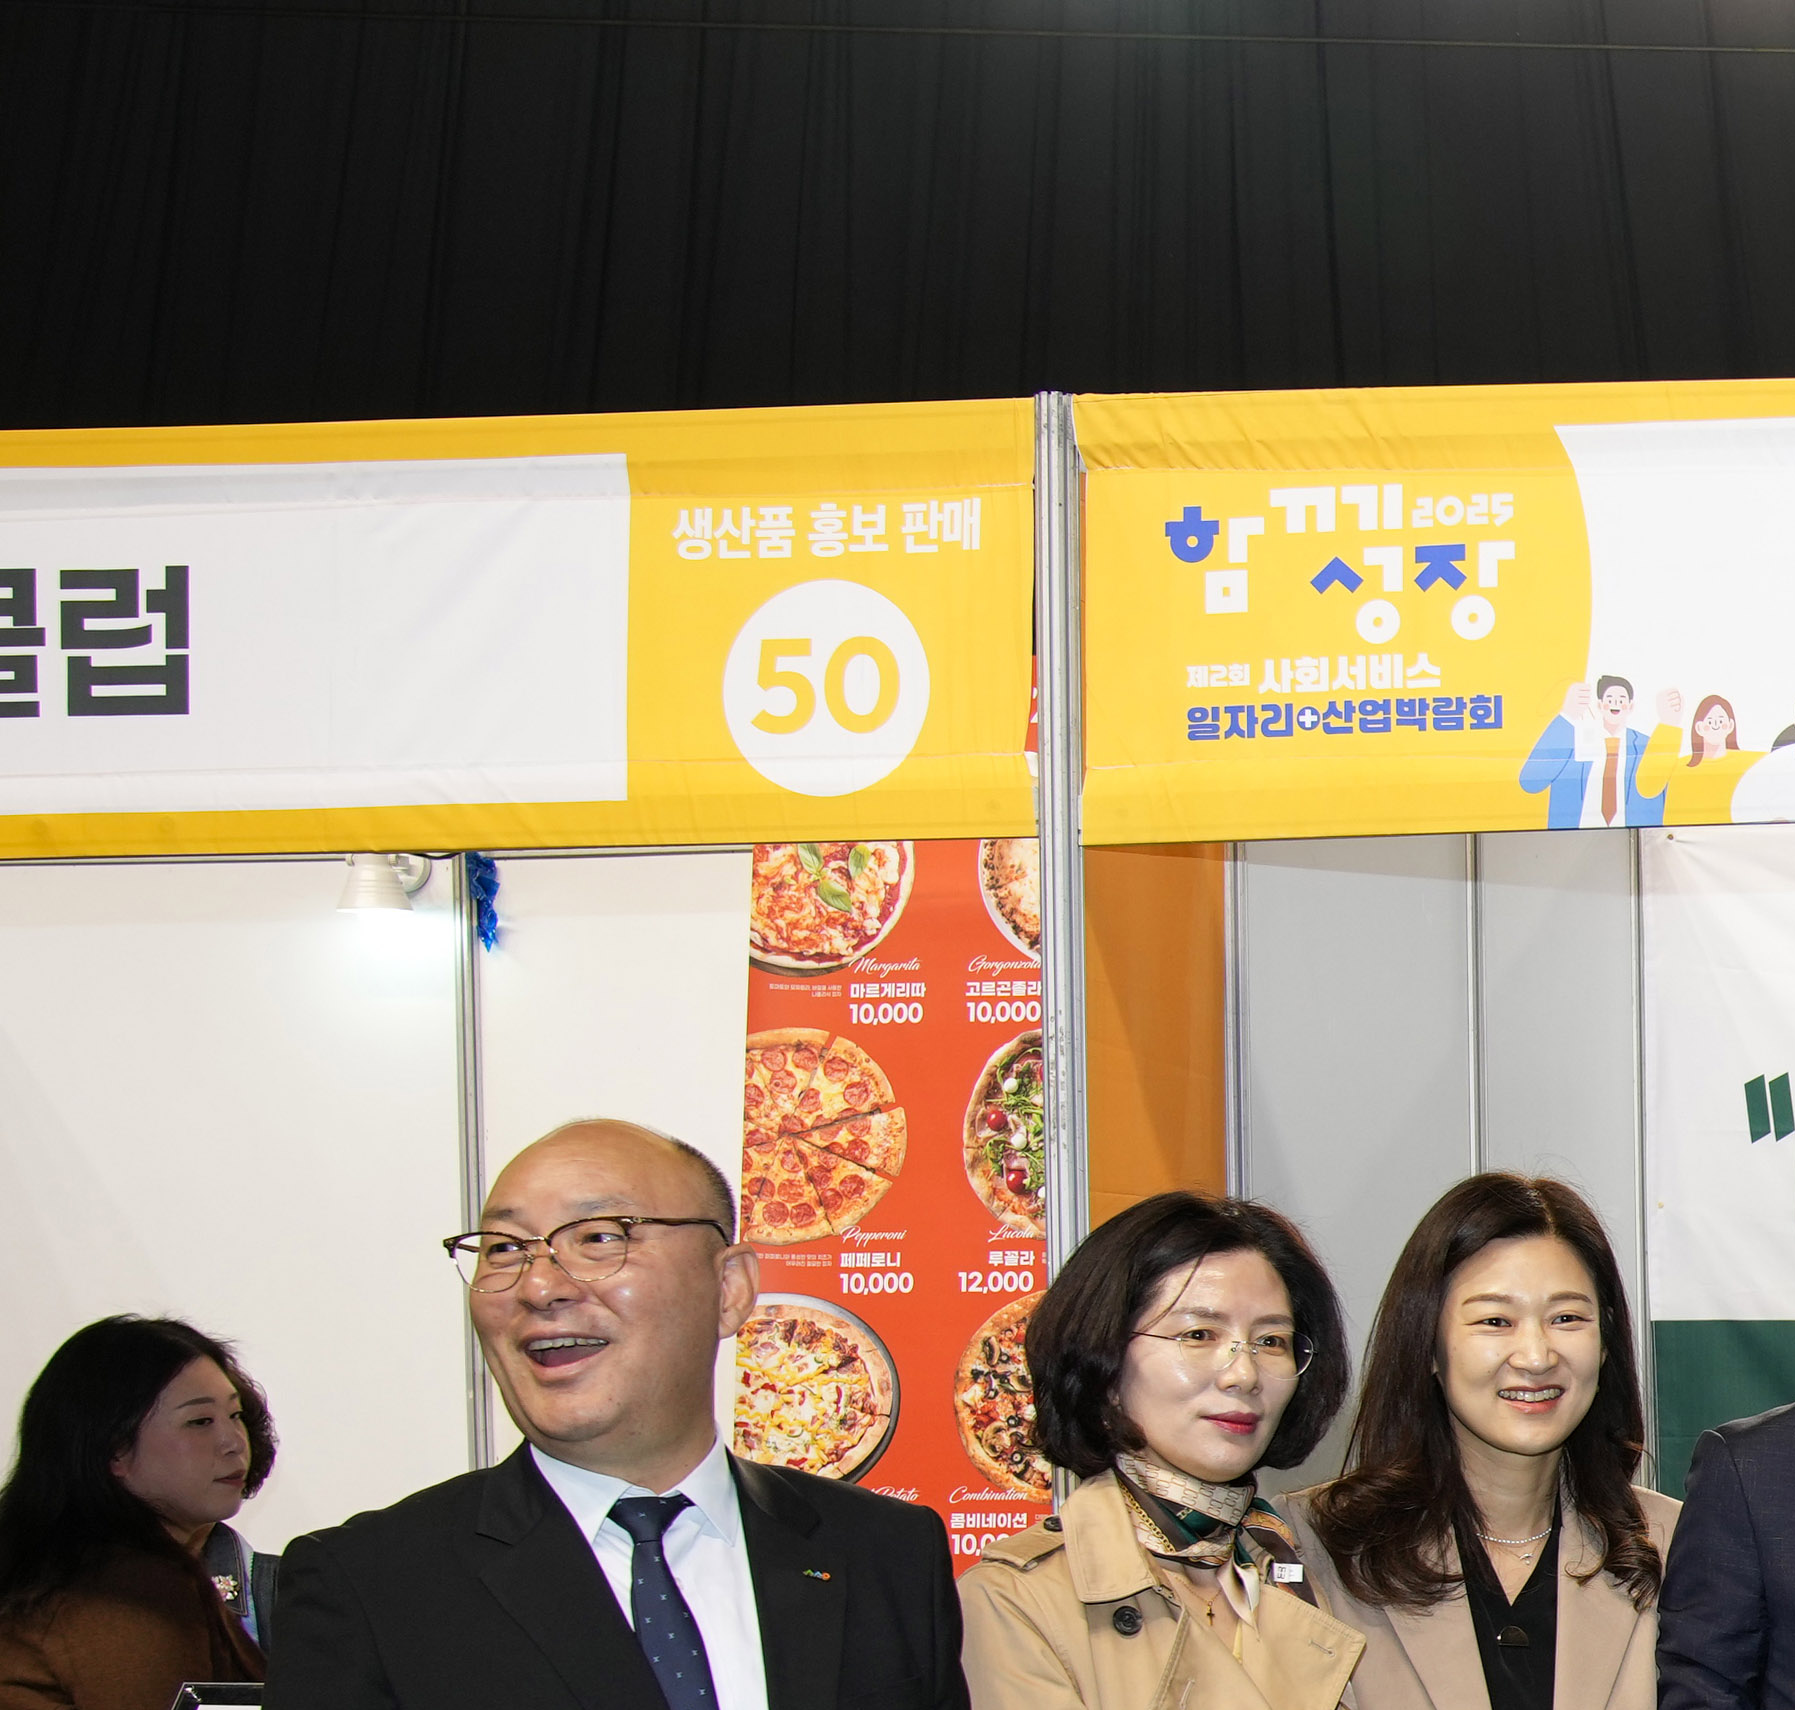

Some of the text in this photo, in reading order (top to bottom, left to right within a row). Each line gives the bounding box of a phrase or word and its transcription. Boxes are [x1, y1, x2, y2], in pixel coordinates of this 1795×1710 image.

[1412, 492, 1515, 530] 2025
[671, 497, 982, 561] 생산품 홍보 판매
[1185, 652, 1442, 695] 제2회 사회서비스
[748, 635, 900, 736] 50
[850, 956, 923, 978] Margarita
[850, 982, 926, 998] 마르게리따
[849, 1003, 923, 1025] 10,000
[966, 1001, 1041, 1023] 10,000
[839, 1225, 907, 1248] Pepperoni
[840, 1251, 901, 1268] 페페로니
[988, 1250, 1035, 1267] 루꼴라
[840, 1272, 914, 1295] 10,000
[958, 1271, 1035, 1294] 12,000
[949, 1486, 1029, 1504] Combination
[950, 1512, 1028, 1529] 콤비네이션
